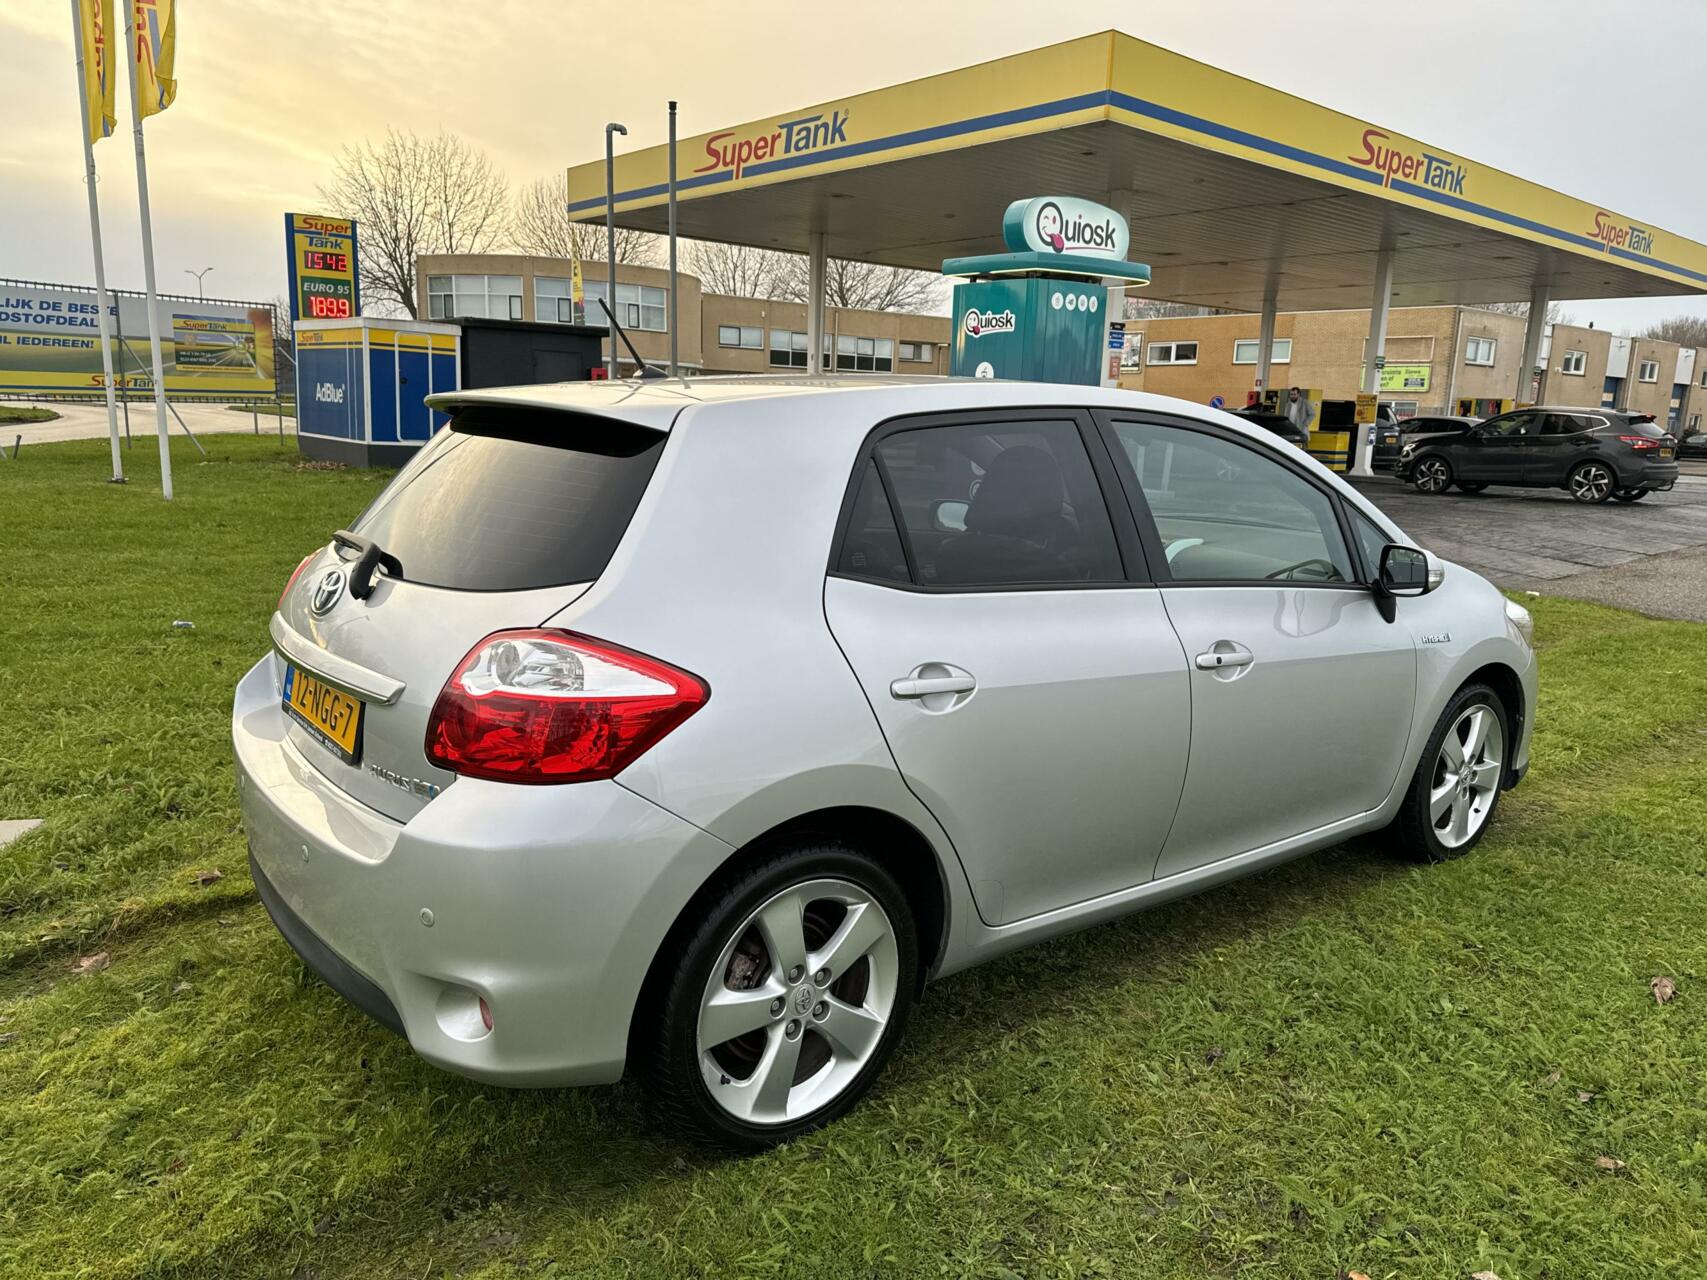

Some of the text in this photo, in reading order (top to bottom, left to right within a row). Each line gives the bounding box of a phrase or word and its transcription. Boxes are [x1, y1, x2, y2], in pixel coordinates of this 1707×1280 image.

[693, 111, 848, 180] SuperTank
[1347, 129, 1466, 195] SuperTank
[296, 217, 351, 236] Super
[1036, 201, 1116, 253] Quiosk
[1585, 211, 1653, 255] SuperTank
[304, 236, 343, 249] Tank
[303, 282, 350, 294] EURO 95
[39, 300, 62, 312] DE
[68, 303, 119, 316] BESE
[310, 296, 350, 317] 189.9
[965, 309, 1014, 335] Quiosk
[16, 336, 94, 349] IEDEREEN!
[296, 671, 354, 739] 12-NGG-7
